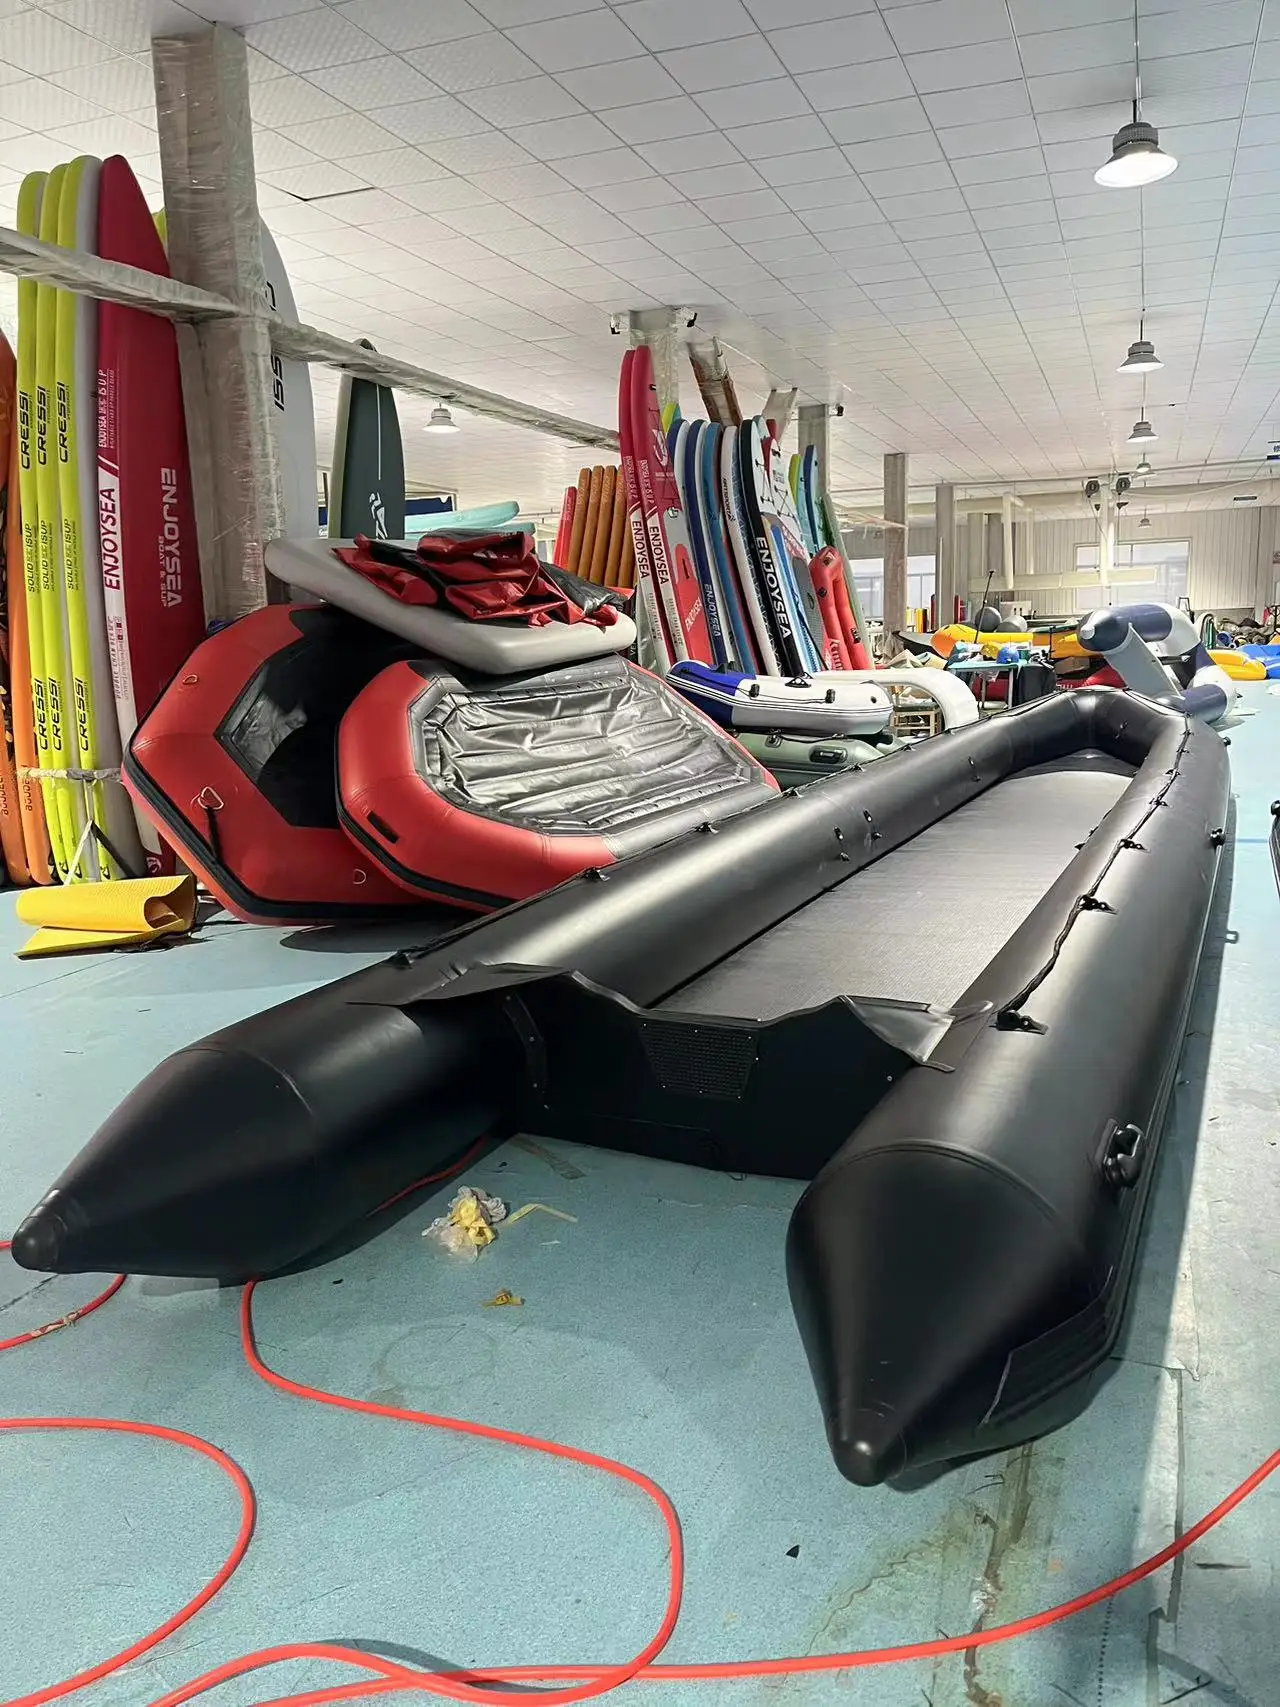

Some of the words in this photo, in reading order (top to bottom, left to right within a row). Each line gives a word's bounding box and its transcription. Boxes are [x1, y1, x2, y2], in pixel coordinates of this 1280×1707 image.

[19, 391, 30, 469] CRESSI
[37, 386, 46, 465] CRESSI
[57, 382, 68, 463] CRESSI
[98, 416, 107, 448] ENJOYSEA
[25, 523, 33, 548] ISUP
[100, 488, 120, 590] ENJOYSEA
[161, 467, 182, 607] ENJOYSEA
[632, 521, 650, 579] ENJOYSEA
[649, 526, 669, 584] ENJOYSEA
[27, 563, 35, 592] SOLID
[41, 560, 49, 590] SOLID
[159, 570, 165, 578] &
[704, 584, 721, 636] ENJOYSEA
[756, 536, 791, 638] ENJOYSEA
[34, 678, 48, 750] CRESSI
[48, 677, 61, 750] CRESSI
[75, 677, 88, 751] CRESSI
